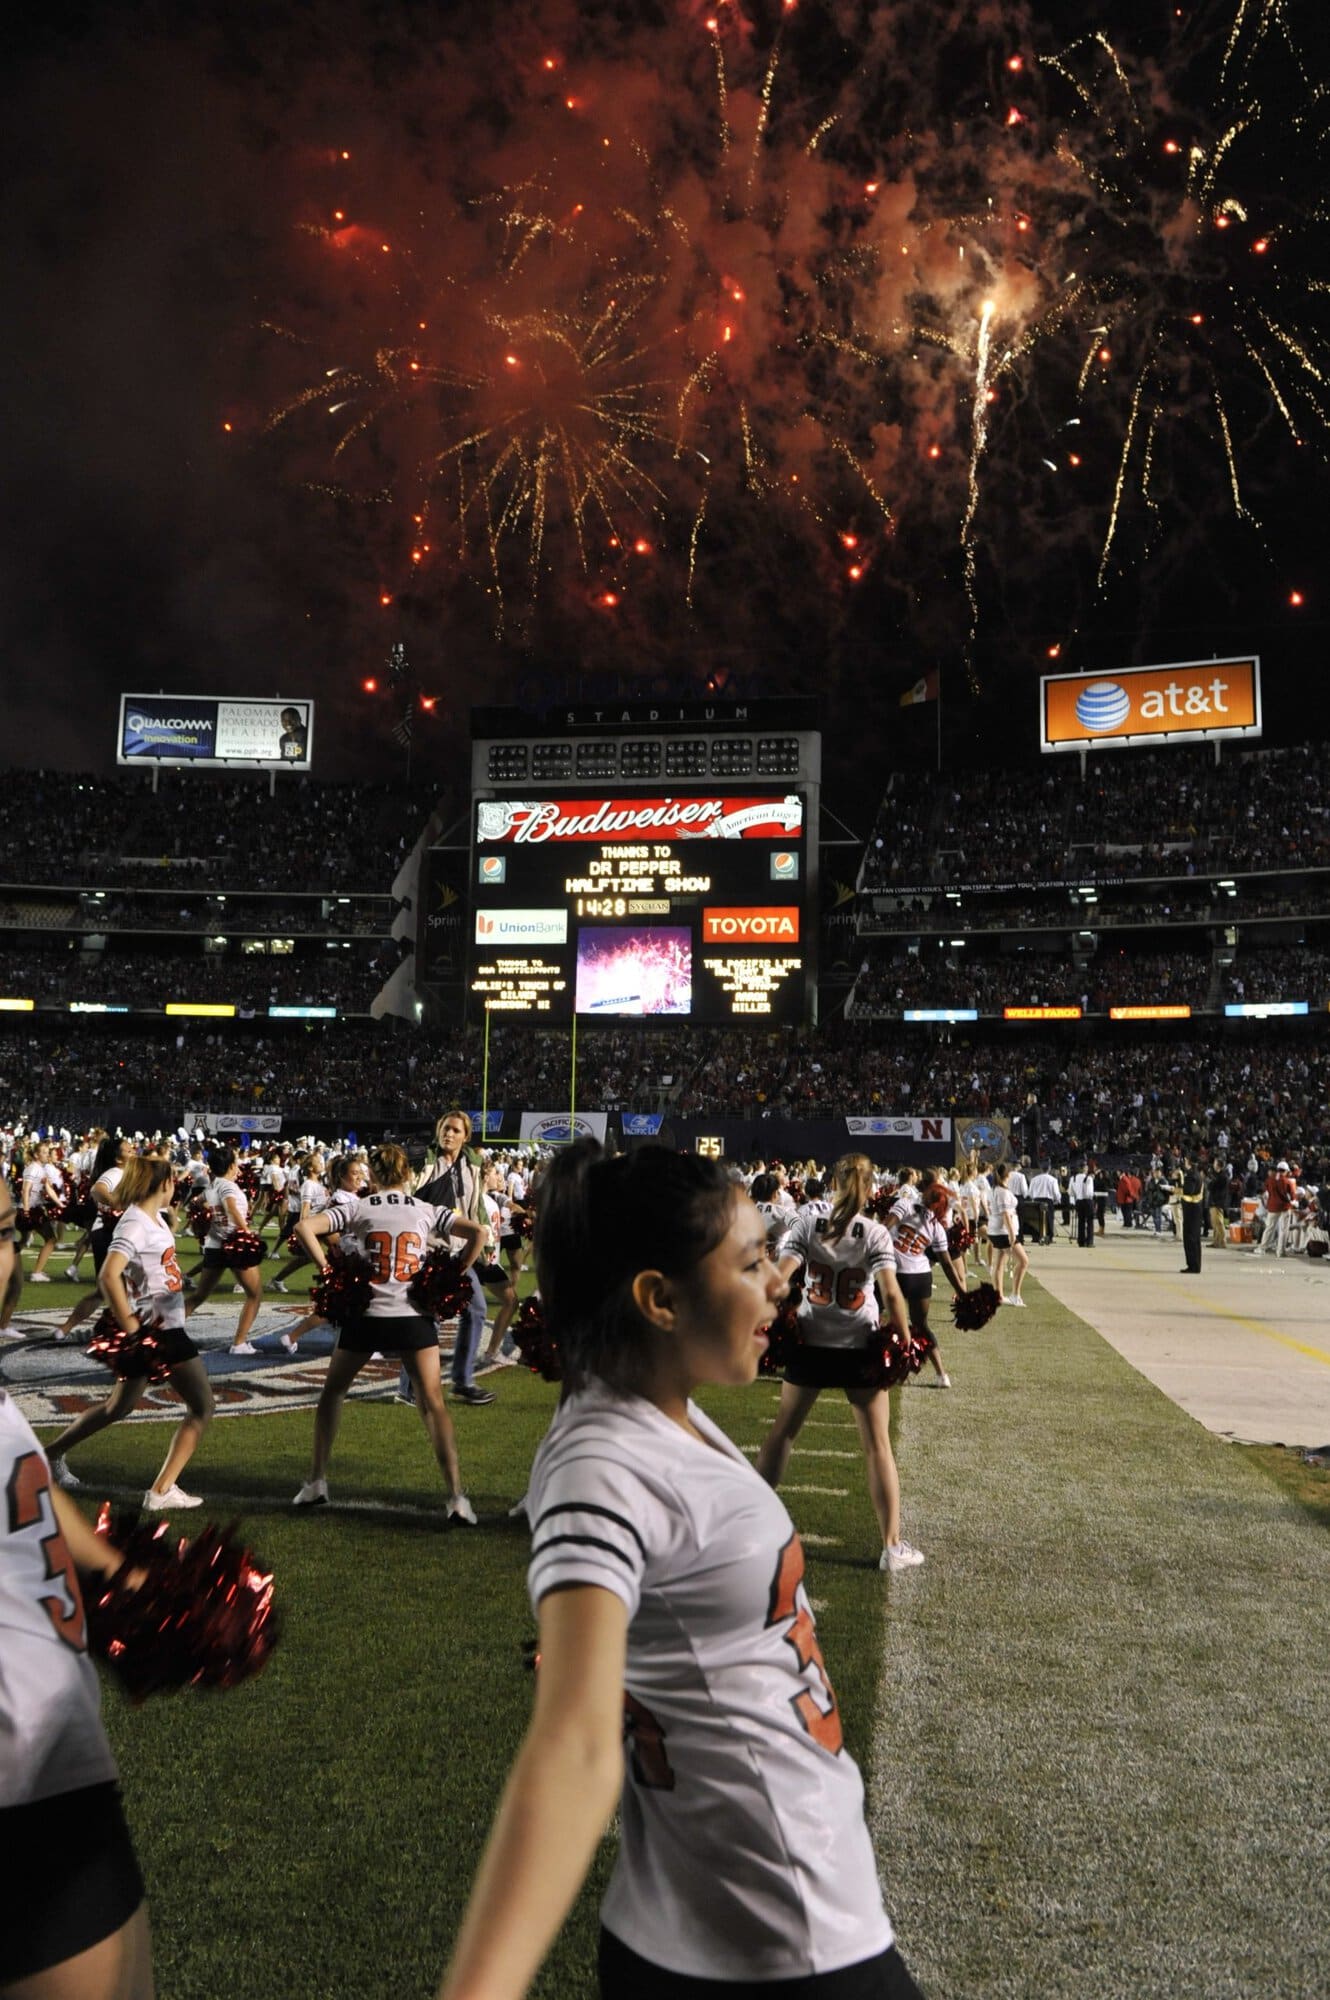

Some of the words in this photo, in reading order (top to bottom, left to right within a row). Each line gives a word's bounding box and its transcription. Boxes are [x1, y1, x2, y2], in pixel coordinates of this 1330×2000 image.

[1140, 678, 1229, 719] at&t
[222, 707, 280, 717] PALOMAR
[567, 707, 747, 723] STADIUM
[128, 715, 212, 734] QUALCOMM
[221, 718, 279, 727] POMERADO
[144, 734, 198, 745] Innovation
[221, 728, 279, 737] HEALTH
[505, 798, 723, 843] Budweiser
[601, 846, 649, 859] THANKS
[653, 845, 671, 858] TO
[589, 861, 613, 876] DR
[619, 860, 681, 875] PEPPER
[565, 878, 655, 893] HALFTIME
[664, 877, 711, 892] SHOW
[577, 898, 626, 917] 14:28
[499, 922, 565, 933] UnionBank
[708, 917, 795, 935] TOYOTA
[1007, 1008, 1044, 1018] WELLS
[1044, 1008, 1079, 1017] FARGO
[920, 1119, 943, 1140] N
[699, 1137, 721, 1156] 25
[369, 1194, 416, 1207] BGA
[815, 1218, 864, 1239] BA
[364, 1231, 422, 1285] 36
